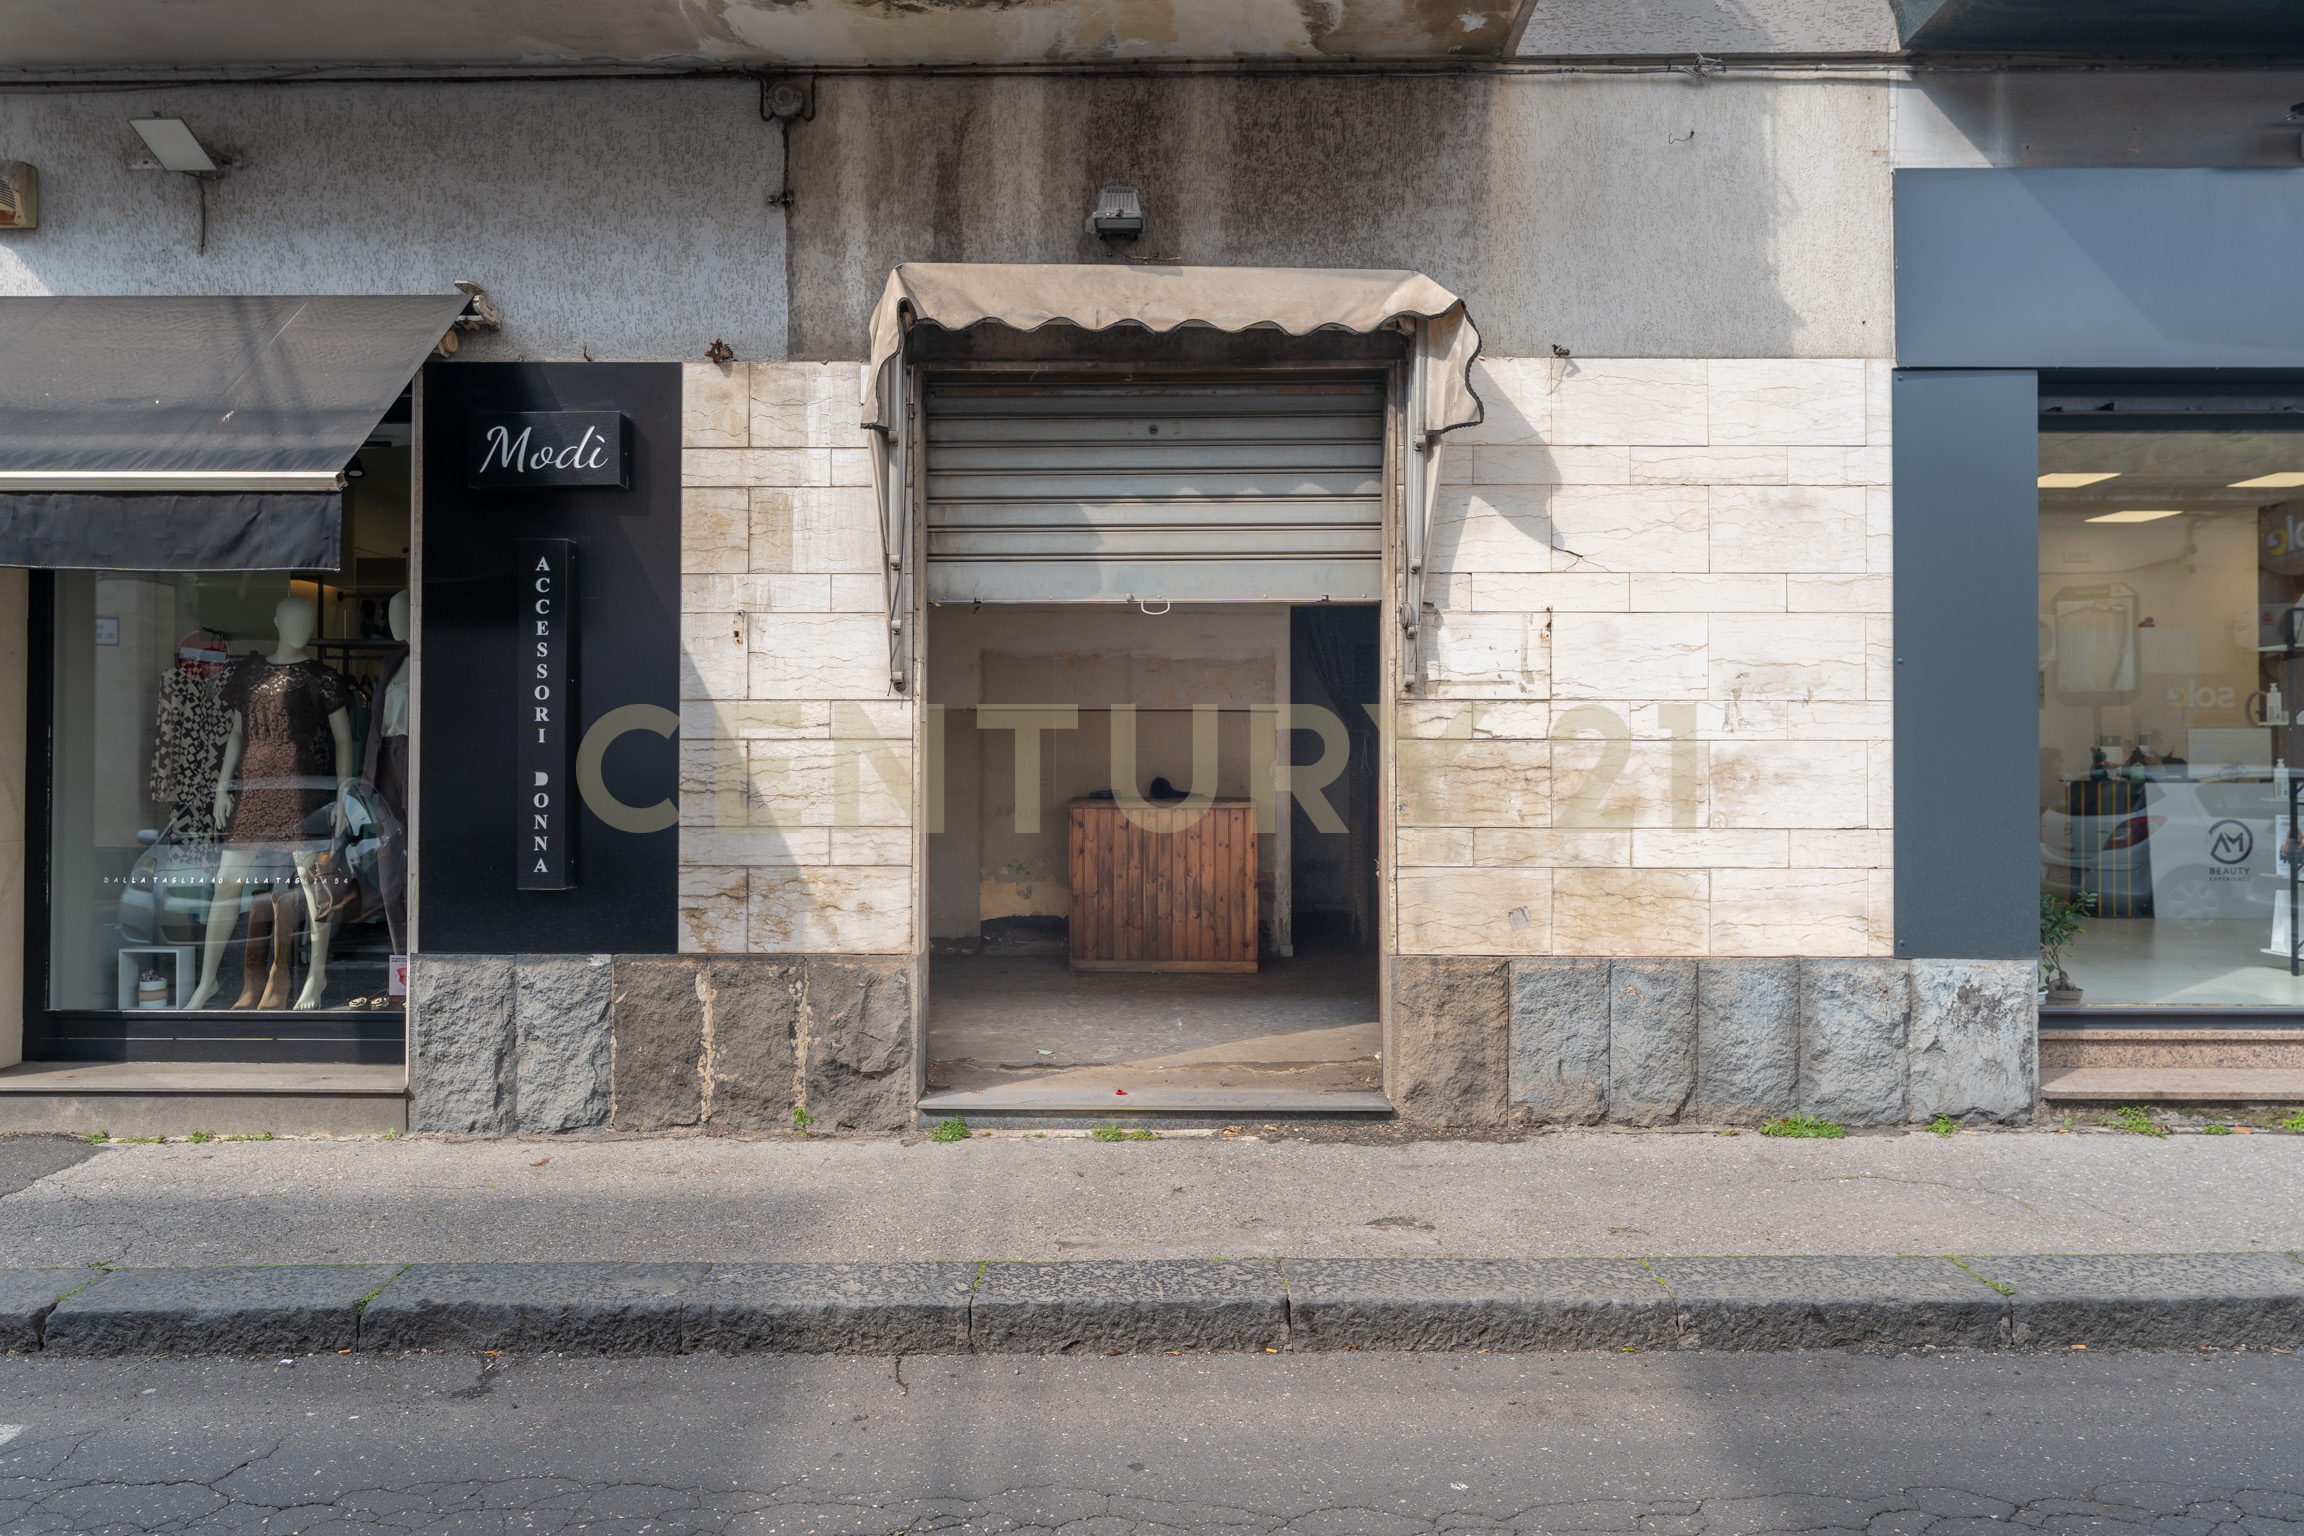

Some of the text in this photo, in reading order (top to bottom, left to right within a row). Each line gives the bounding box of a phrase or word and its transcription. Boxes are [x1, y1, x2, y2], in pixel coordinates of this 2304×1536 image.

[479, 425, 609, 473] Modì
[533, 556, 551, 873] ACCESSORI DONNA
[2209, 867, 2250, 875] BEAUTY
